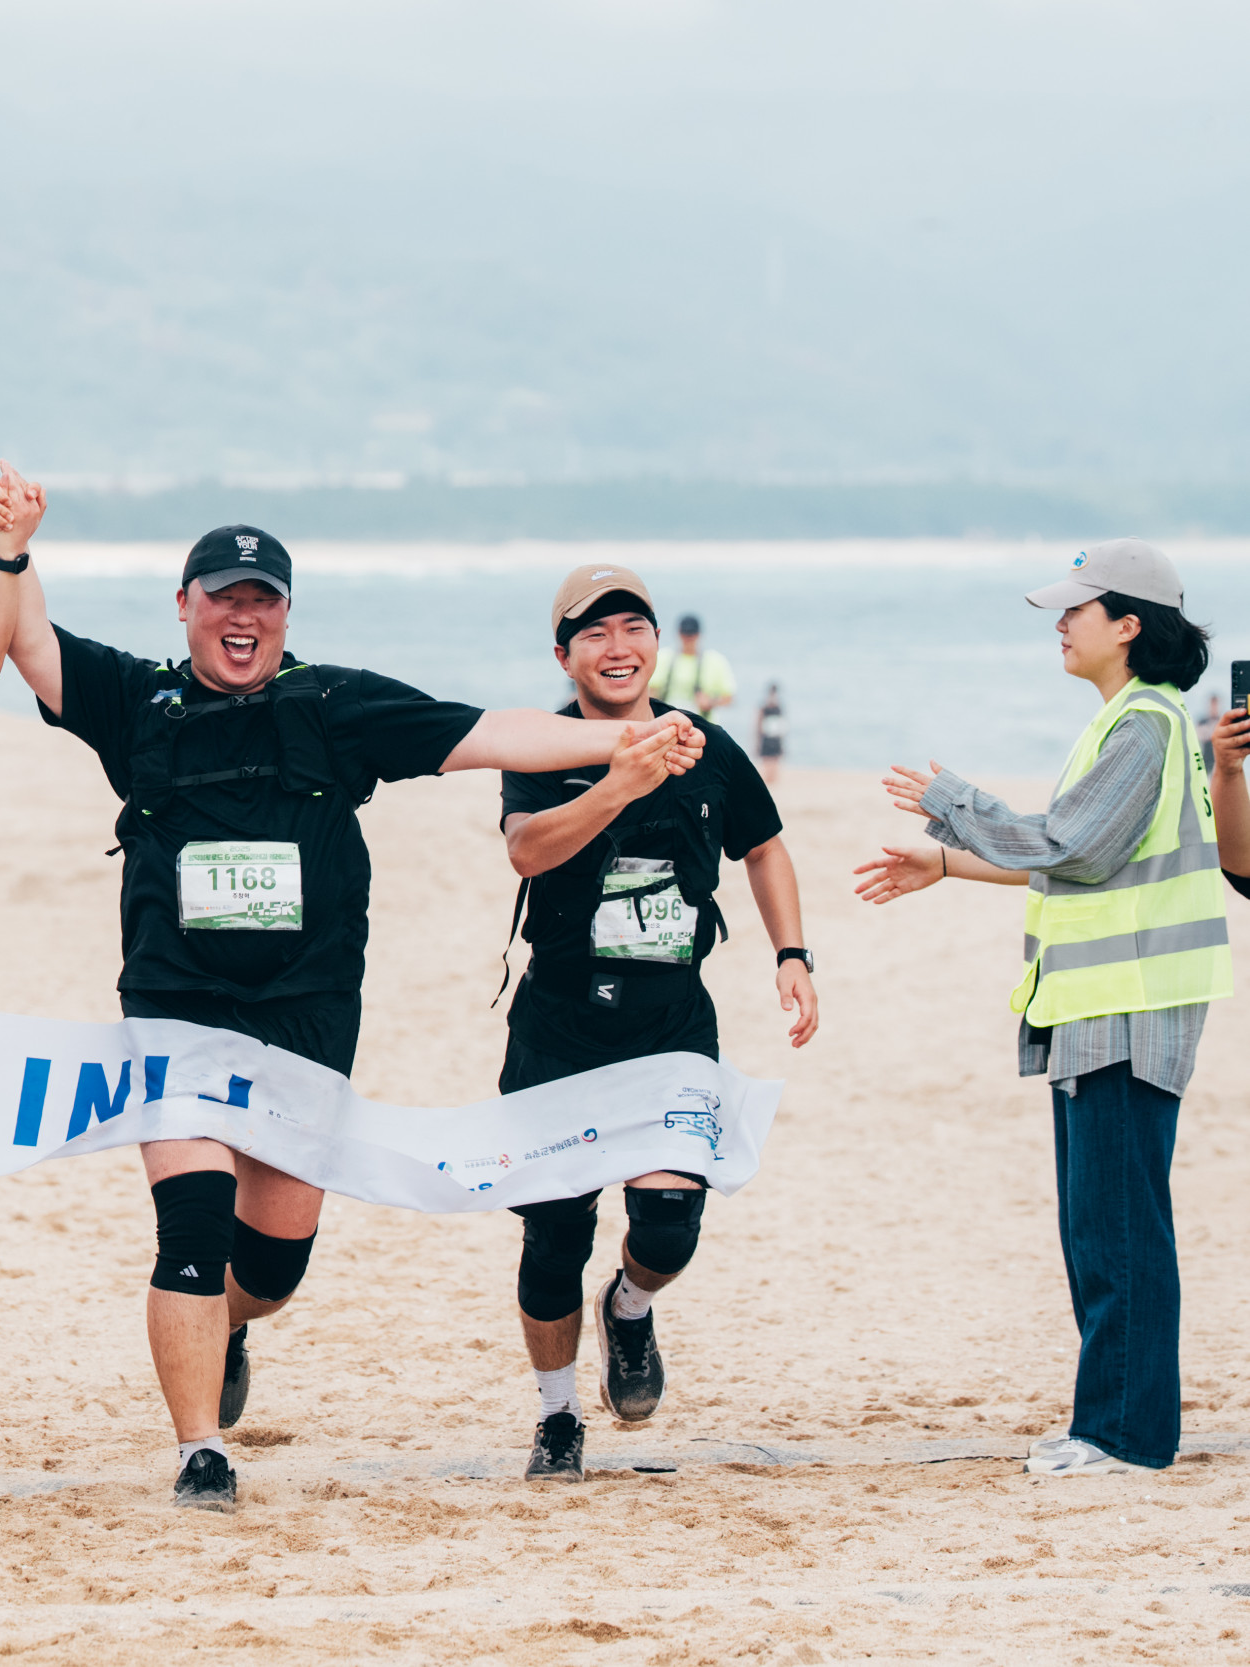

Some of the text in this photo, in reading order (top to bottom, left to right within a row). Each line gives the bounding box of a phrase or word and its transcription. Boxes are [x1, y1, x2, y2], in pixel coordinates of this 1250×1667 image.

[237, 543, 258, 551] TOUR
[207, 866, 277, 891] 1168
[247, 901, 296, 916] 14.5K
[523, 1135, 580, 1161] 문화체육관광부
